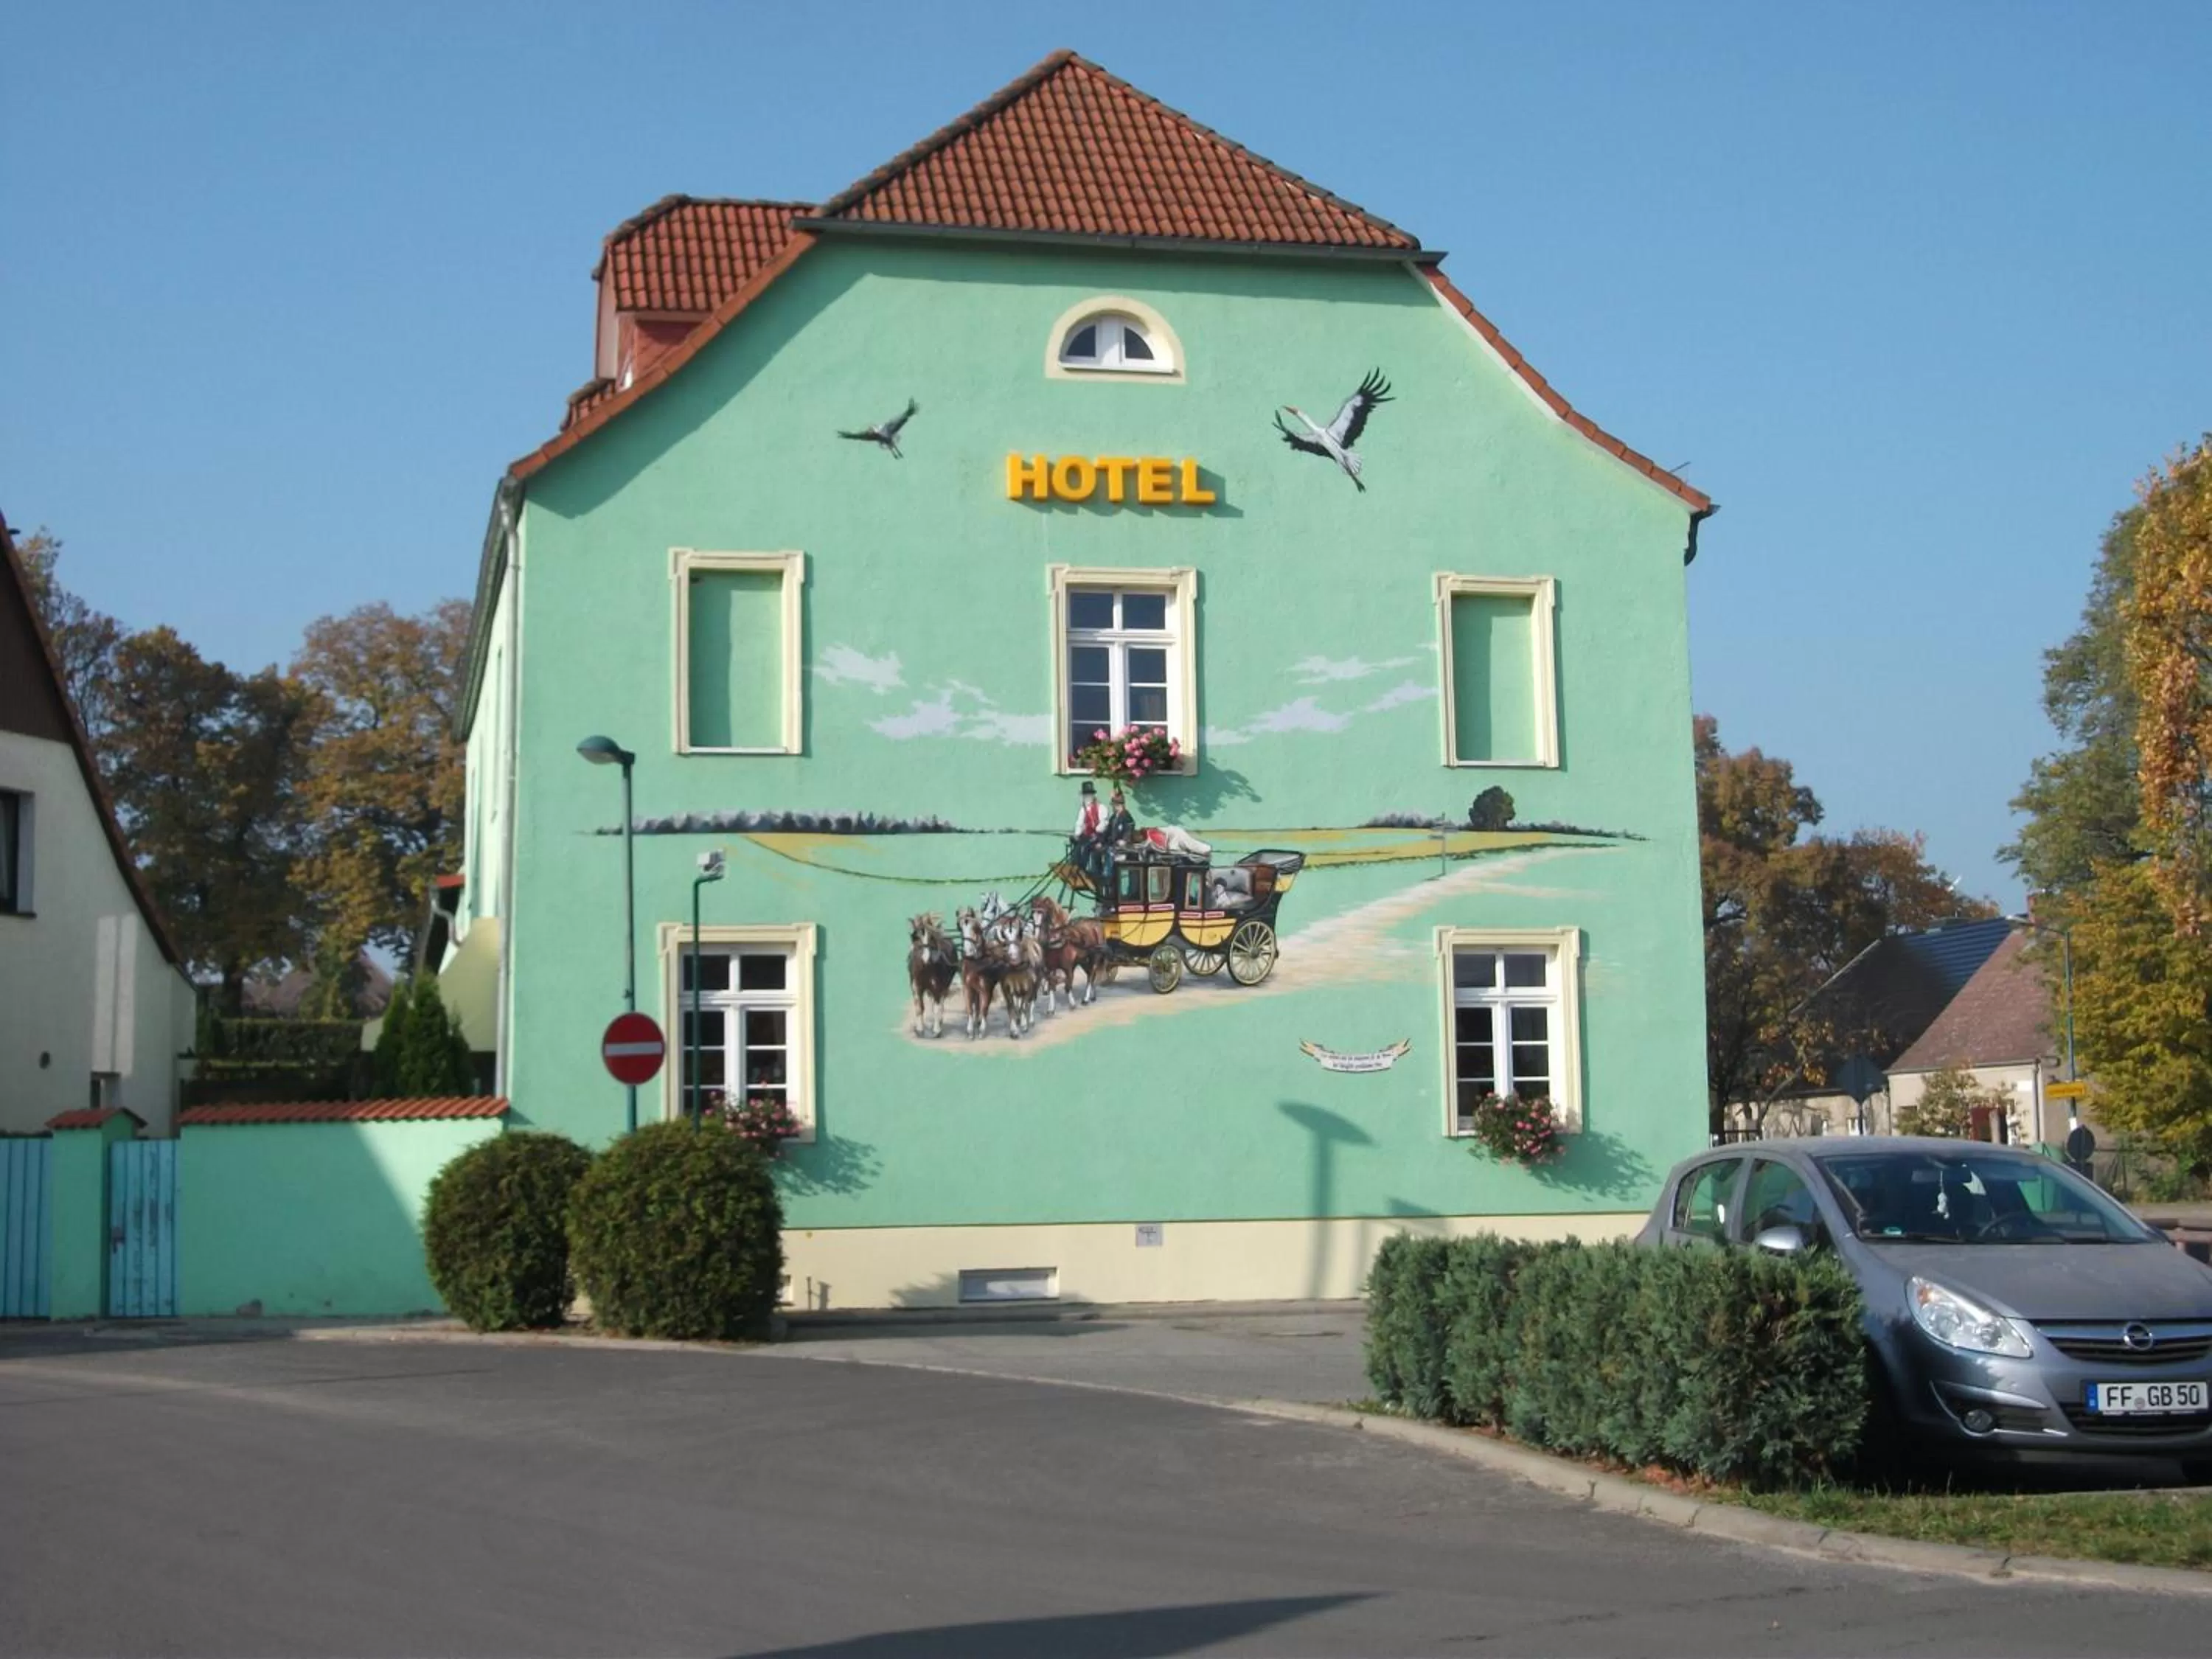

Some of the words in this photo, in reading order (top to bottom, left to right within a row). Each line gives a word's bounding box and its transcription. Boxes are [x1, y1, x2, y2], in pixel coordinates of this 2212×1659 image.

[1006, 452, 1216, 504] HOTEL
[2107, 1385, 2132, 1407] FF
[2147, 1385, 2173, 1406] GB
[2177, 1384, 2200, 1405] 50
